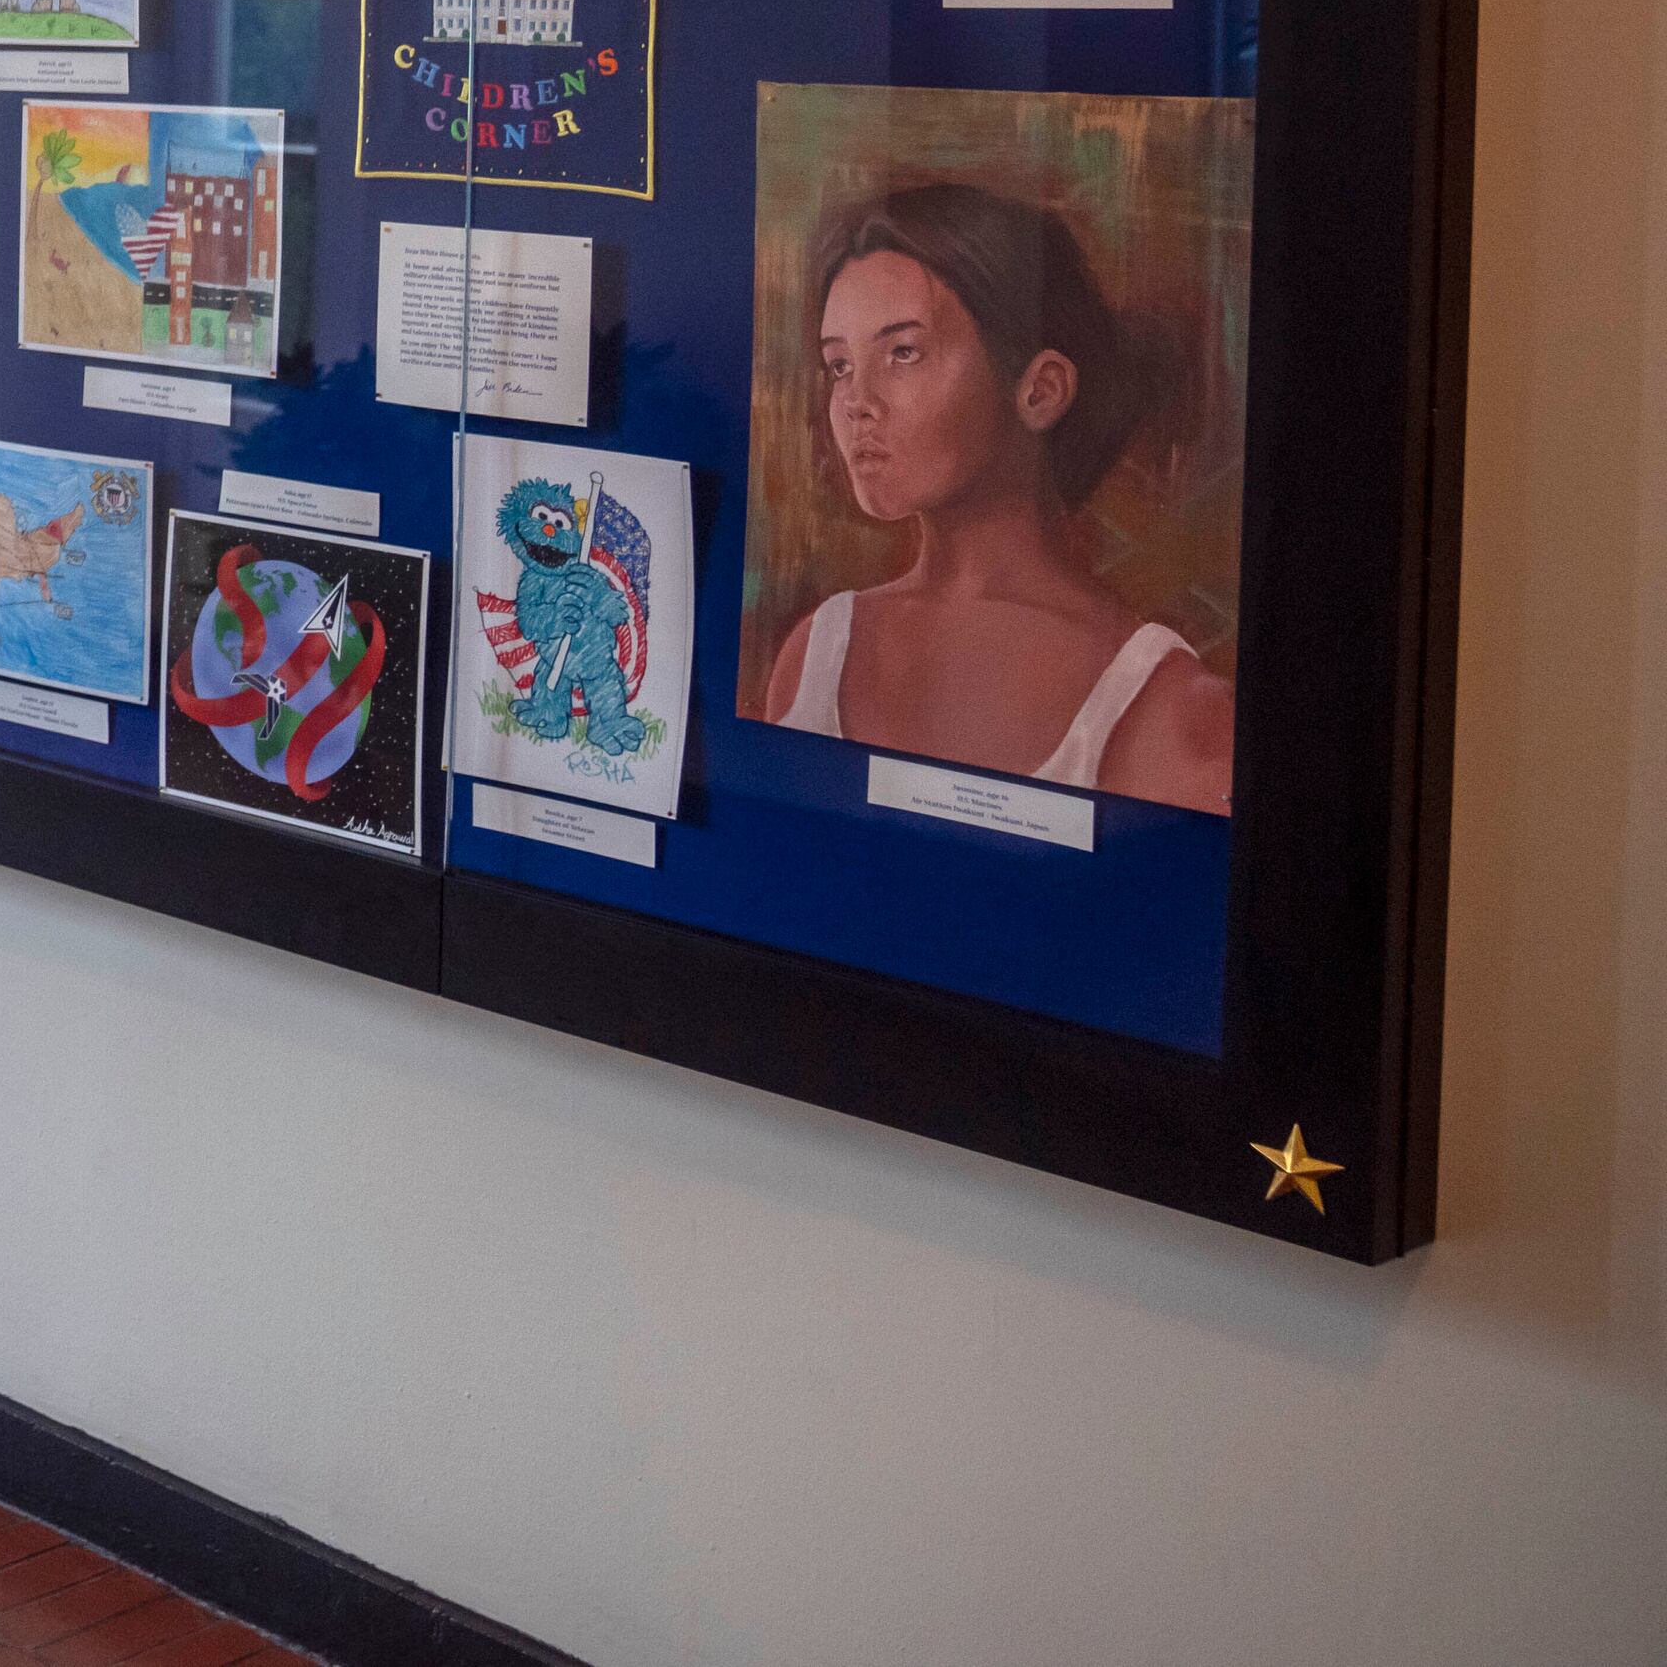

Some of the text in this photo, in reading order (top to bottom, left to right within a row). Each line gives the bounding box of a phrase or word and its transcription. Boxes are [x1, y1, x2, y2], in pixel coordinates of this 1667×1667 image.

[393, 44, 619, 111] CHILDREN'S
[425, 106, 581, 150] CORNER
[923, 798, 952, 811] Station
[1026, 820, 1050, 832] Japan
